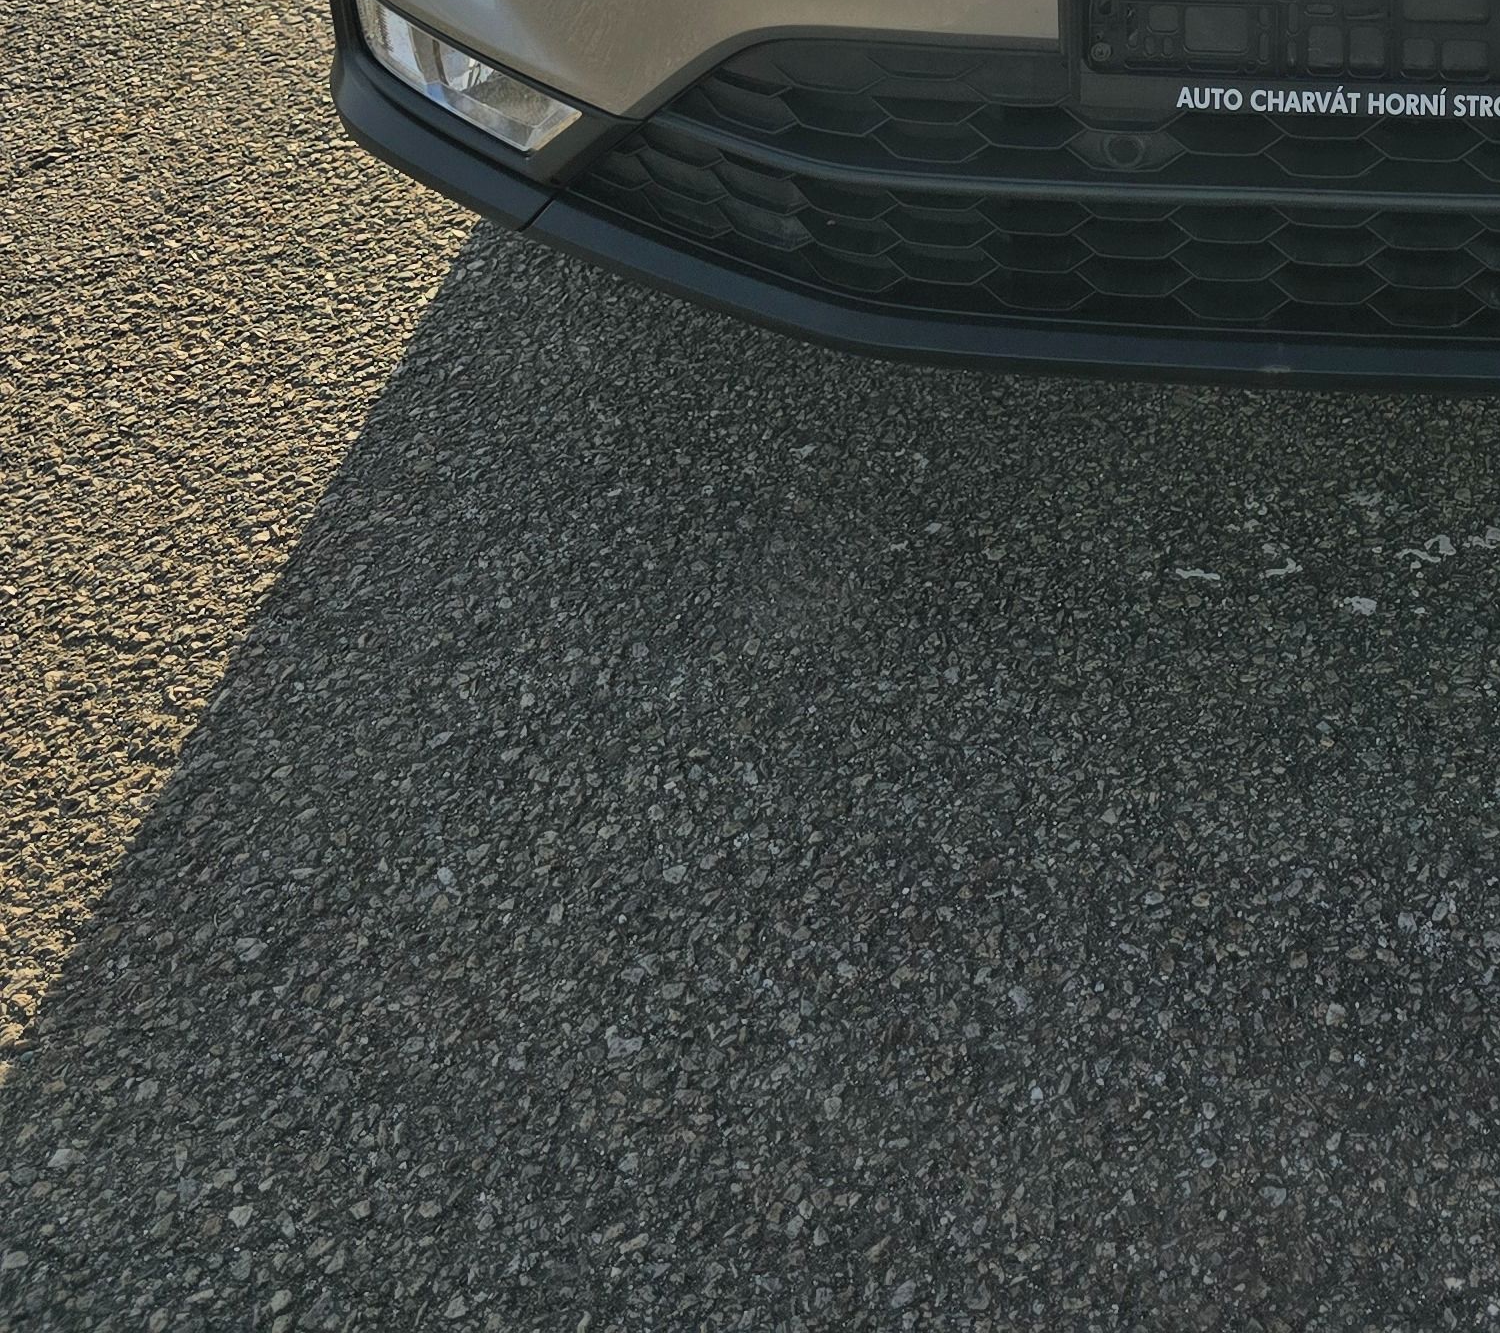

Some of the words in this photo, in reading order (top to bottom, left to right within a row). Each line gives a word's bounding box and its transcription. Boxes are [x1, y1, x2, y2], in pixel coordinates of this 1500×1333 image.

[1176, 86, 1243, 111] AUTO
[1250, 85, 1361, 114] CHARVÁT
[1367, 87, 1447, 117] HORNÍ
